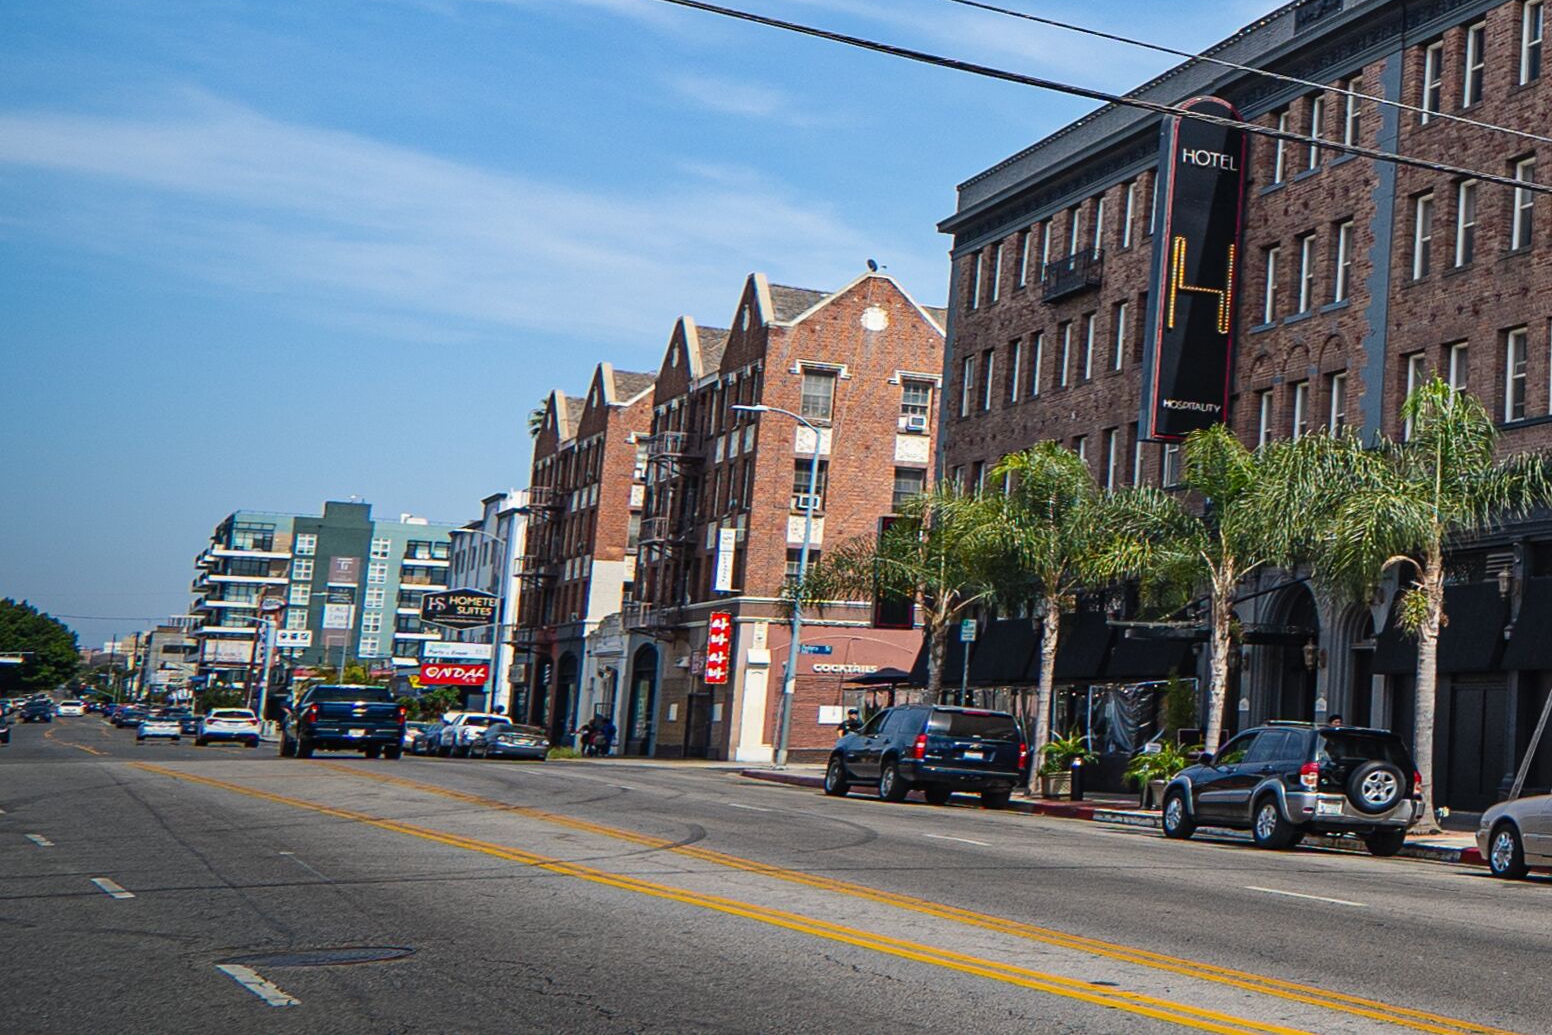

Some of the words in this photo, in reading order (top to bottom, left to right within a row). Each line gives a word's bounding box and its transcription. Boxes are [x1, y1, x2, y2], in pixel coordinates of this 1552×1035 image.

[1182, 148, 1238, 172] HOTEL
[1162, 398, 1222, 414] HOSPITALITY
[448, 596, 498, 607] HOMETE
[456, 606, 493, 616] SUITES
[425, 667, 486, 680] ONDAL
[812, 663, 878, 674] COCKTAILS
